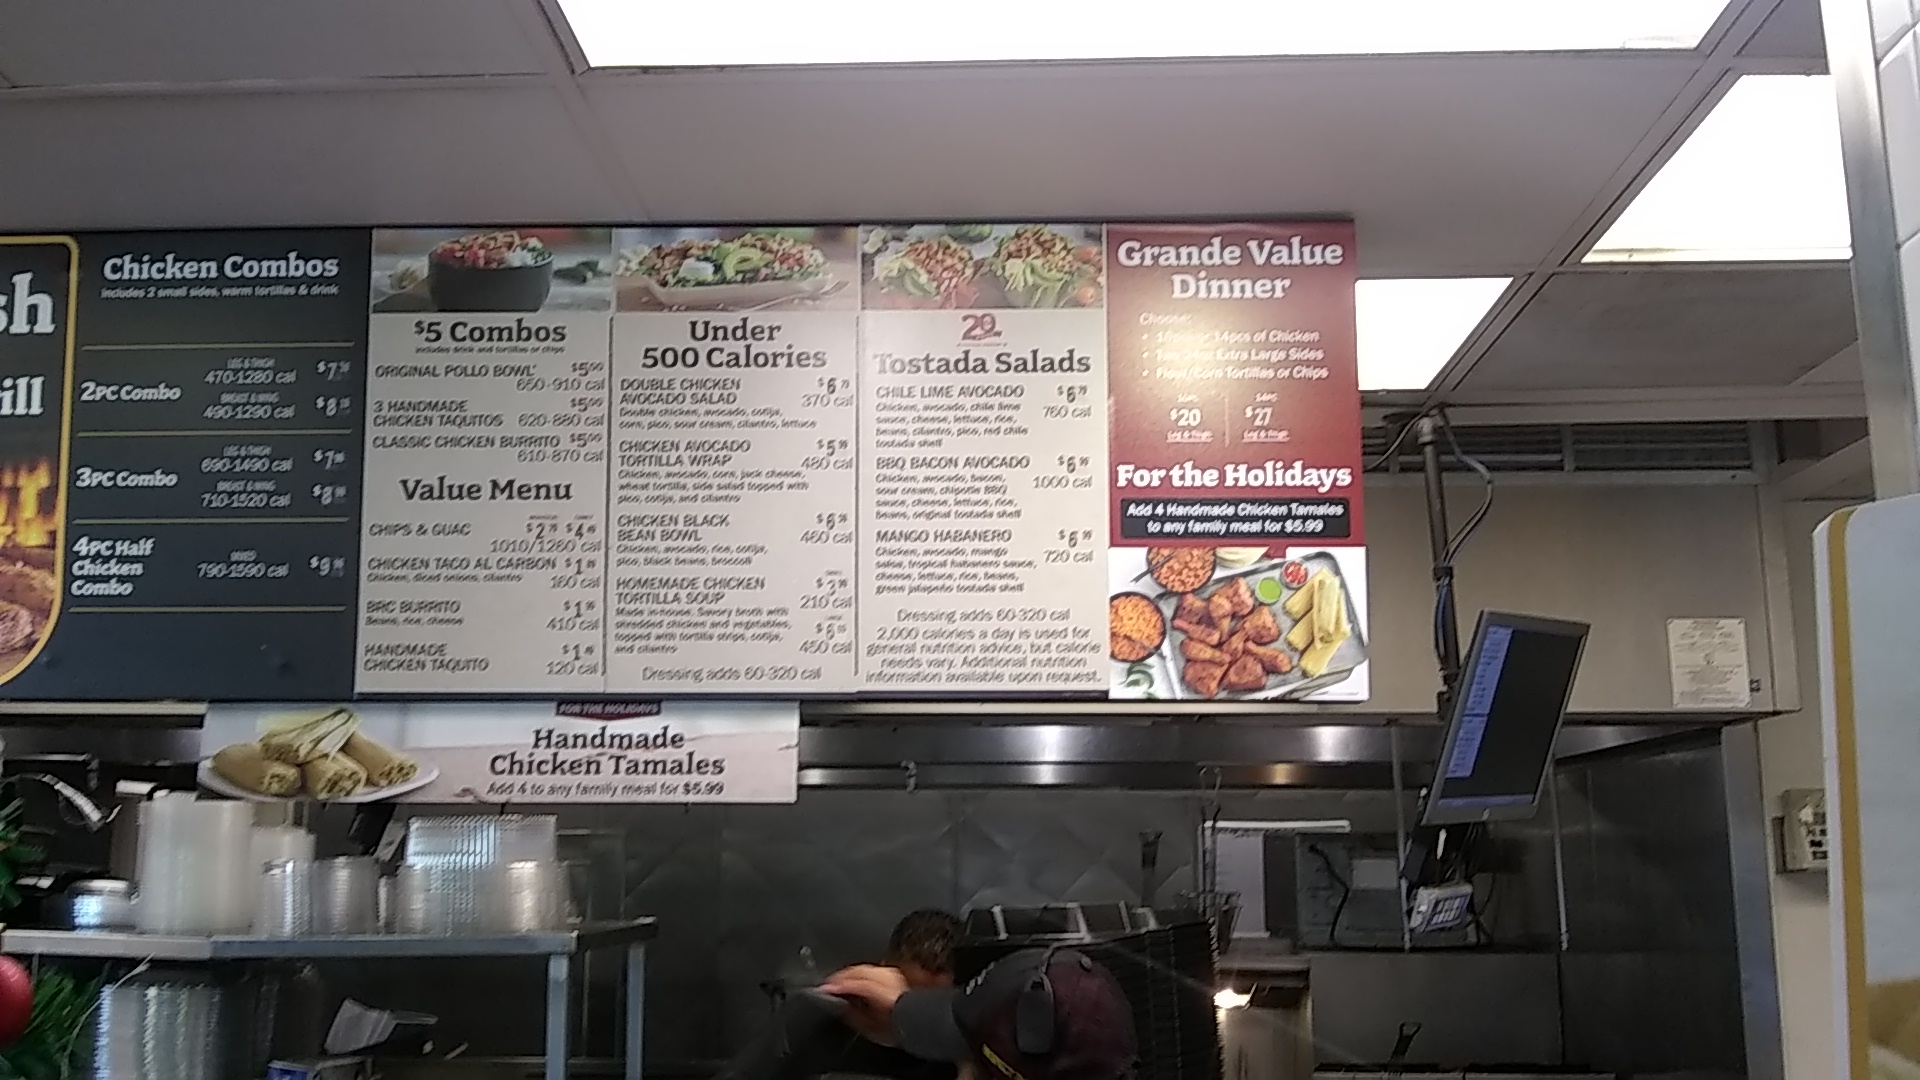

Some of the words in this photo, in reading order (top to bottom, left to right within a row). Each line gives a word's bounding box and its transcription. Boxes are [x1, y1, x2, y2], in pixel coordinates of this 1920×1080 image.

[1117, 237, 1241, 266] Grande
[1247, 236, 1344, 265] Value
[103, 254, 219, 281] Chicken
[224, 251, 339, 279] Combos
[1172, 271, 1291, 299] Dinner
[414, 320, 442, 342] $5
[450, 318, 567, 342] Combos
[689, 317, 781, 342] Under
[642, 347, 699, 368] 500
[706, 344, 827, 368] Calories
[873, 349, 989, 375] Tostada
[996, 349, 1091, 373] Salads
[275, 370, 297, 383] cal
[375, 365, 440, 377] ORIGINAL
[444, 364, 489, 377] POLLO
[80, 382, 118, 401] 2PC
[120, 382, 182, 400] Combo
[620, 379, 676, 391] DOUBLE
[680, 378, 741, 390] CHICKEN
[876, 386, 916, 398] CHILE
[921, 385, 954, 398] LIME
[958, 385, 1025, 398] AVOCADO
[619, 393, 686, 404] AVOCADO
[690, 393, 738, 404] SALAD
[373, 401, 382, 412] 3
[388, 400, 467, 412] HANDMADE
[1071, 406, 1092, 418] cal
[373, 415, 432, 427] CHICKEN
[437, 414, 503, 428] TAQUITOS
[584, 413, 604, 427] cal
[1170, 408, 1200, 426] $20
[1245, 406, 1272, 426] $27
[372, 436, 431, 449] CLASSIC
[435, 435, 495, 448] CHICKEN
[500, 435, 561, 448] BURRITO
[619, 440, 680, 452] CHICKEN
[684, 440, 751, 452] AVOCADO
[583, 449, 603, 462] cal
[619, 455, 684, 467] TORTILLA
[688, 455, 732, 467] WRAP
[833, 456, 853, 470] cal
[876, 457, 906, 471] BBQ
[910, 456, 959, 469] BACON
[963, 456, 1030, 469] AVOCADO
[76, 468, 114, 487] 3PC
[117, 470, 177, 487] Combo
[1072, 476, 1093, 488] cal
[1116, 464, 1166, 487] For
[1169, 461, 1219, 487] the
[1224, 460, 1352, 493] Holidays
[400, 476, 482, 500] Value
[489, 478, 573, 500] Menu
[269, 493, 291, 507] cal
[1126, 504, 1152, 516] Add
[1154, 503, 1164, 515] 4
[1166, 503, 1235, 516] Handmade
[1237, 503, 1288, 516] Chicken
[1289, 503, 1344, 516] Tamales
[617, 514, 679, 527] CHICKEN
[683, 514, 730, 527] BLACK
[1147, 521, 1160, 532] to
[1163, 522, 1186, 535] any
[1188, 520, 1227, 534] family
[1229, 520, 1262, 532] meal
[1265, 520, 1282, 532] for
[1285, 519, 1324, 532] $5.99
[369, 524, 412, 536] CHIPS
[416, 523, 428, 535] &
[432, 523, 472, 535] GUAC
[617, 530, 656, 542] BEAN
[660, 529, 703, 542] BOWL
[832, 530, 853, 543] cal
[875, 530, 929, 542] MANGO
[934, 529, 1012, 542] HABANERO
[72, 536, 112, 556] 4PC
[116, 538, 155, 556] Half
[580, 540, 601, 553] cal
[1073, 550, 1093, 562] cal
[72, 559, 143, 577] Chicken
[368, 558, 430, 570] CHICKEN
[435, 557, 470, 570] TACO
[474, 557, 491, 570] AL
[496, 557, 557, 570] CARBON
[71, 580, 133, 596] Combo
[579, 575, 600, 588] cal
[615, 577, 699, 590] HOMEMADE
[703, 577, 766, 590] CHICKEN
[615, 593, 682, 605] TORTILLA
[685, 592, 726, 605] SOUP
[832, 595, 853, 609] cal
[366, 601, 395, 613] BRC
[400, 600, 461, 613] BURRITO
[897, 609, 956, 624] Dressing
[959, 608, 993, 621] adds
[1050, 608, 1070, 621] cal
[578, 618, 599, 630] cal
[364, 643, 448, 656] HANDMADE
[831, 640, 852, 654] cal
[364, 659, 426, 672] CHICKEN
[431, 658, 489, 674] TAQUITO
[577, 662, 598, 675] cal
[532, 726, 684, 750] Handmade
[489, 751, 600, 777] Chicken
[608, 752, 725, 776] Tamales
[487, 783, 514, 795] Add
[517, 783, 528, 795] 4
[531, 784, 544, 795] to
[546, 784, 572, 797] any
[575, 782, 618, 797] family
[621, 783, 657, 795] meal
[660, 783, 678, 795] for
[681, 782, 724, 796] $5.99
